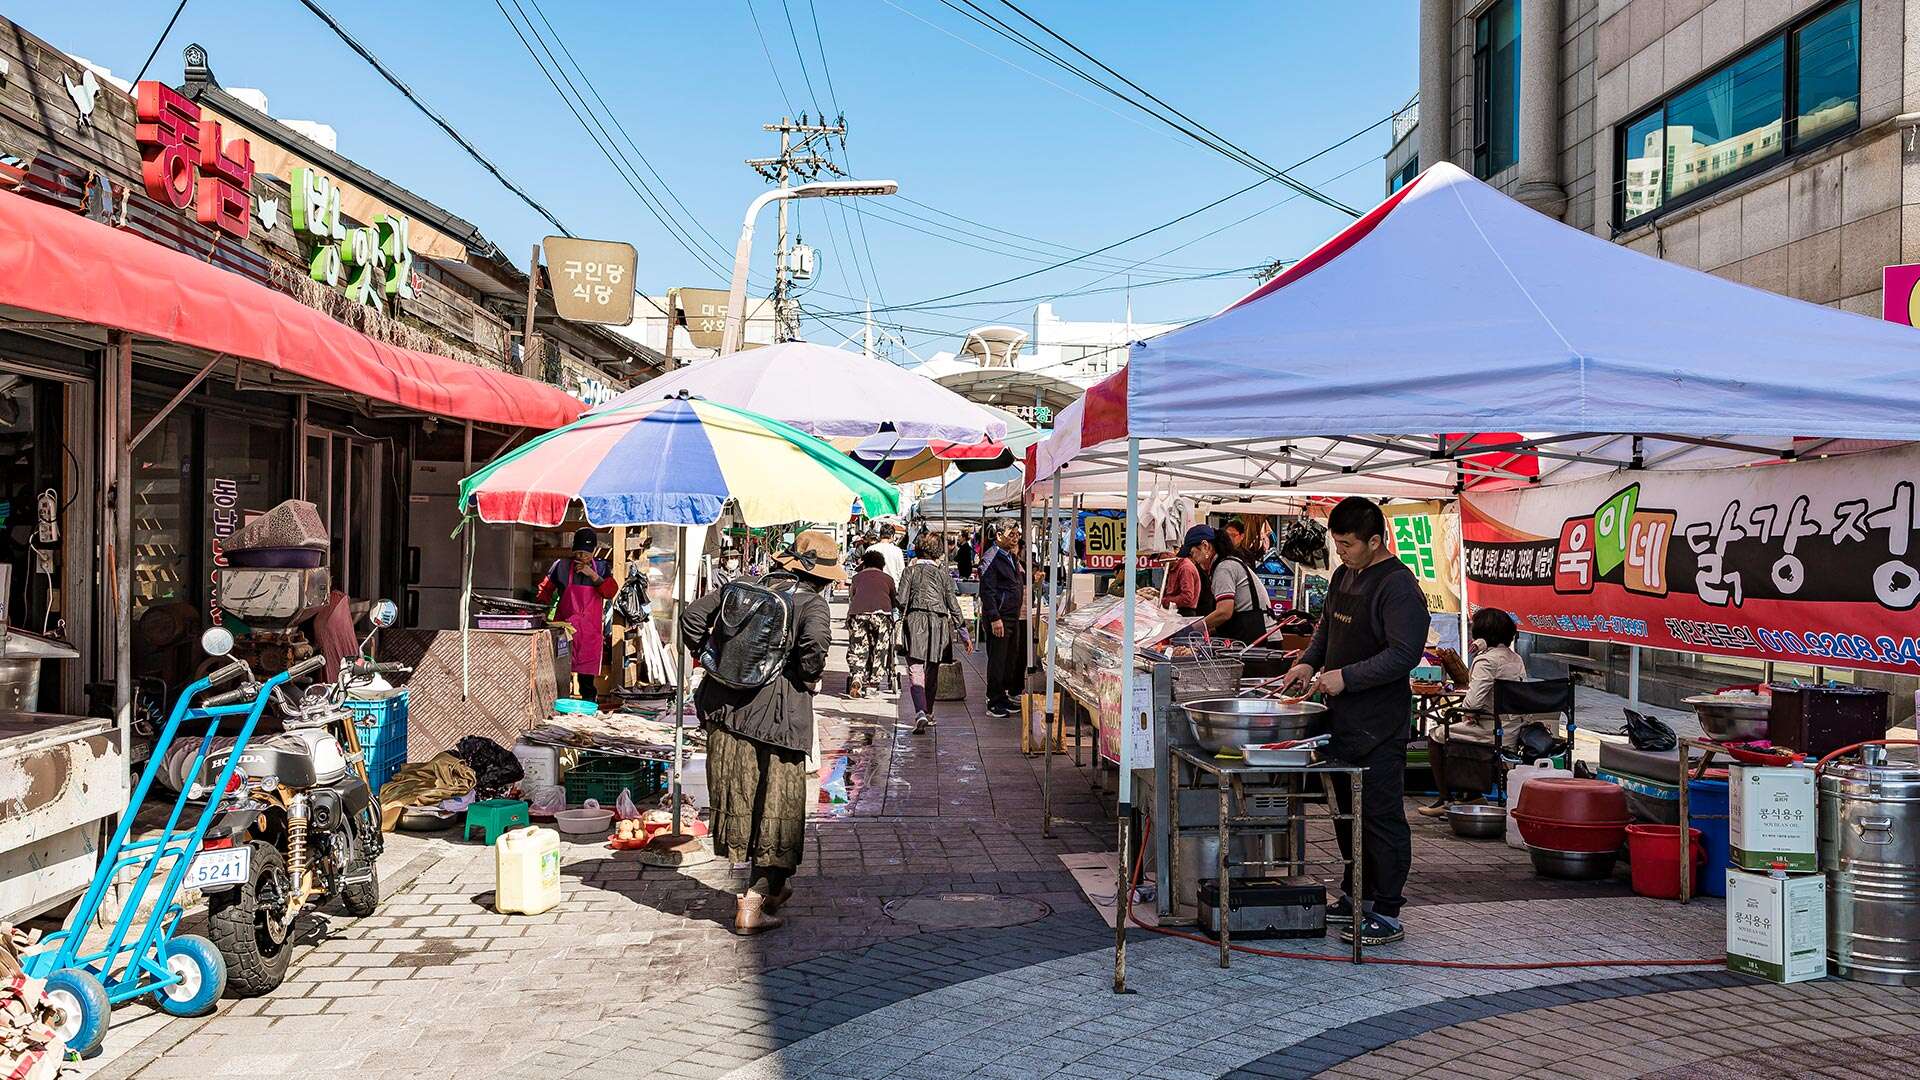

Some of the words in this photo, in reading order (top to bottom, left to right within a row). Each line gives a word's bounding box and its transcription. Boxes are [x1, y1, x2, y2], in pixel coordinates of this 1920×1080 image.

[139, 80, 253, 240] 동남
[291, 167, 414, 313] 방앗간
[564, 260, 625, 284] 구인당
[572, 284, 614, 305] 식당
[1392, 513, 1437, 580] 족발
[1556, 489, 1672, 592] 욱이네
[1686, 481, 1920, 612] 닭강정
[1664, 618, 1765, 652] 체인점문의
[1757, 627, 1920, 666] 010.9208.84
[198, 861, 241, 881] 5241
